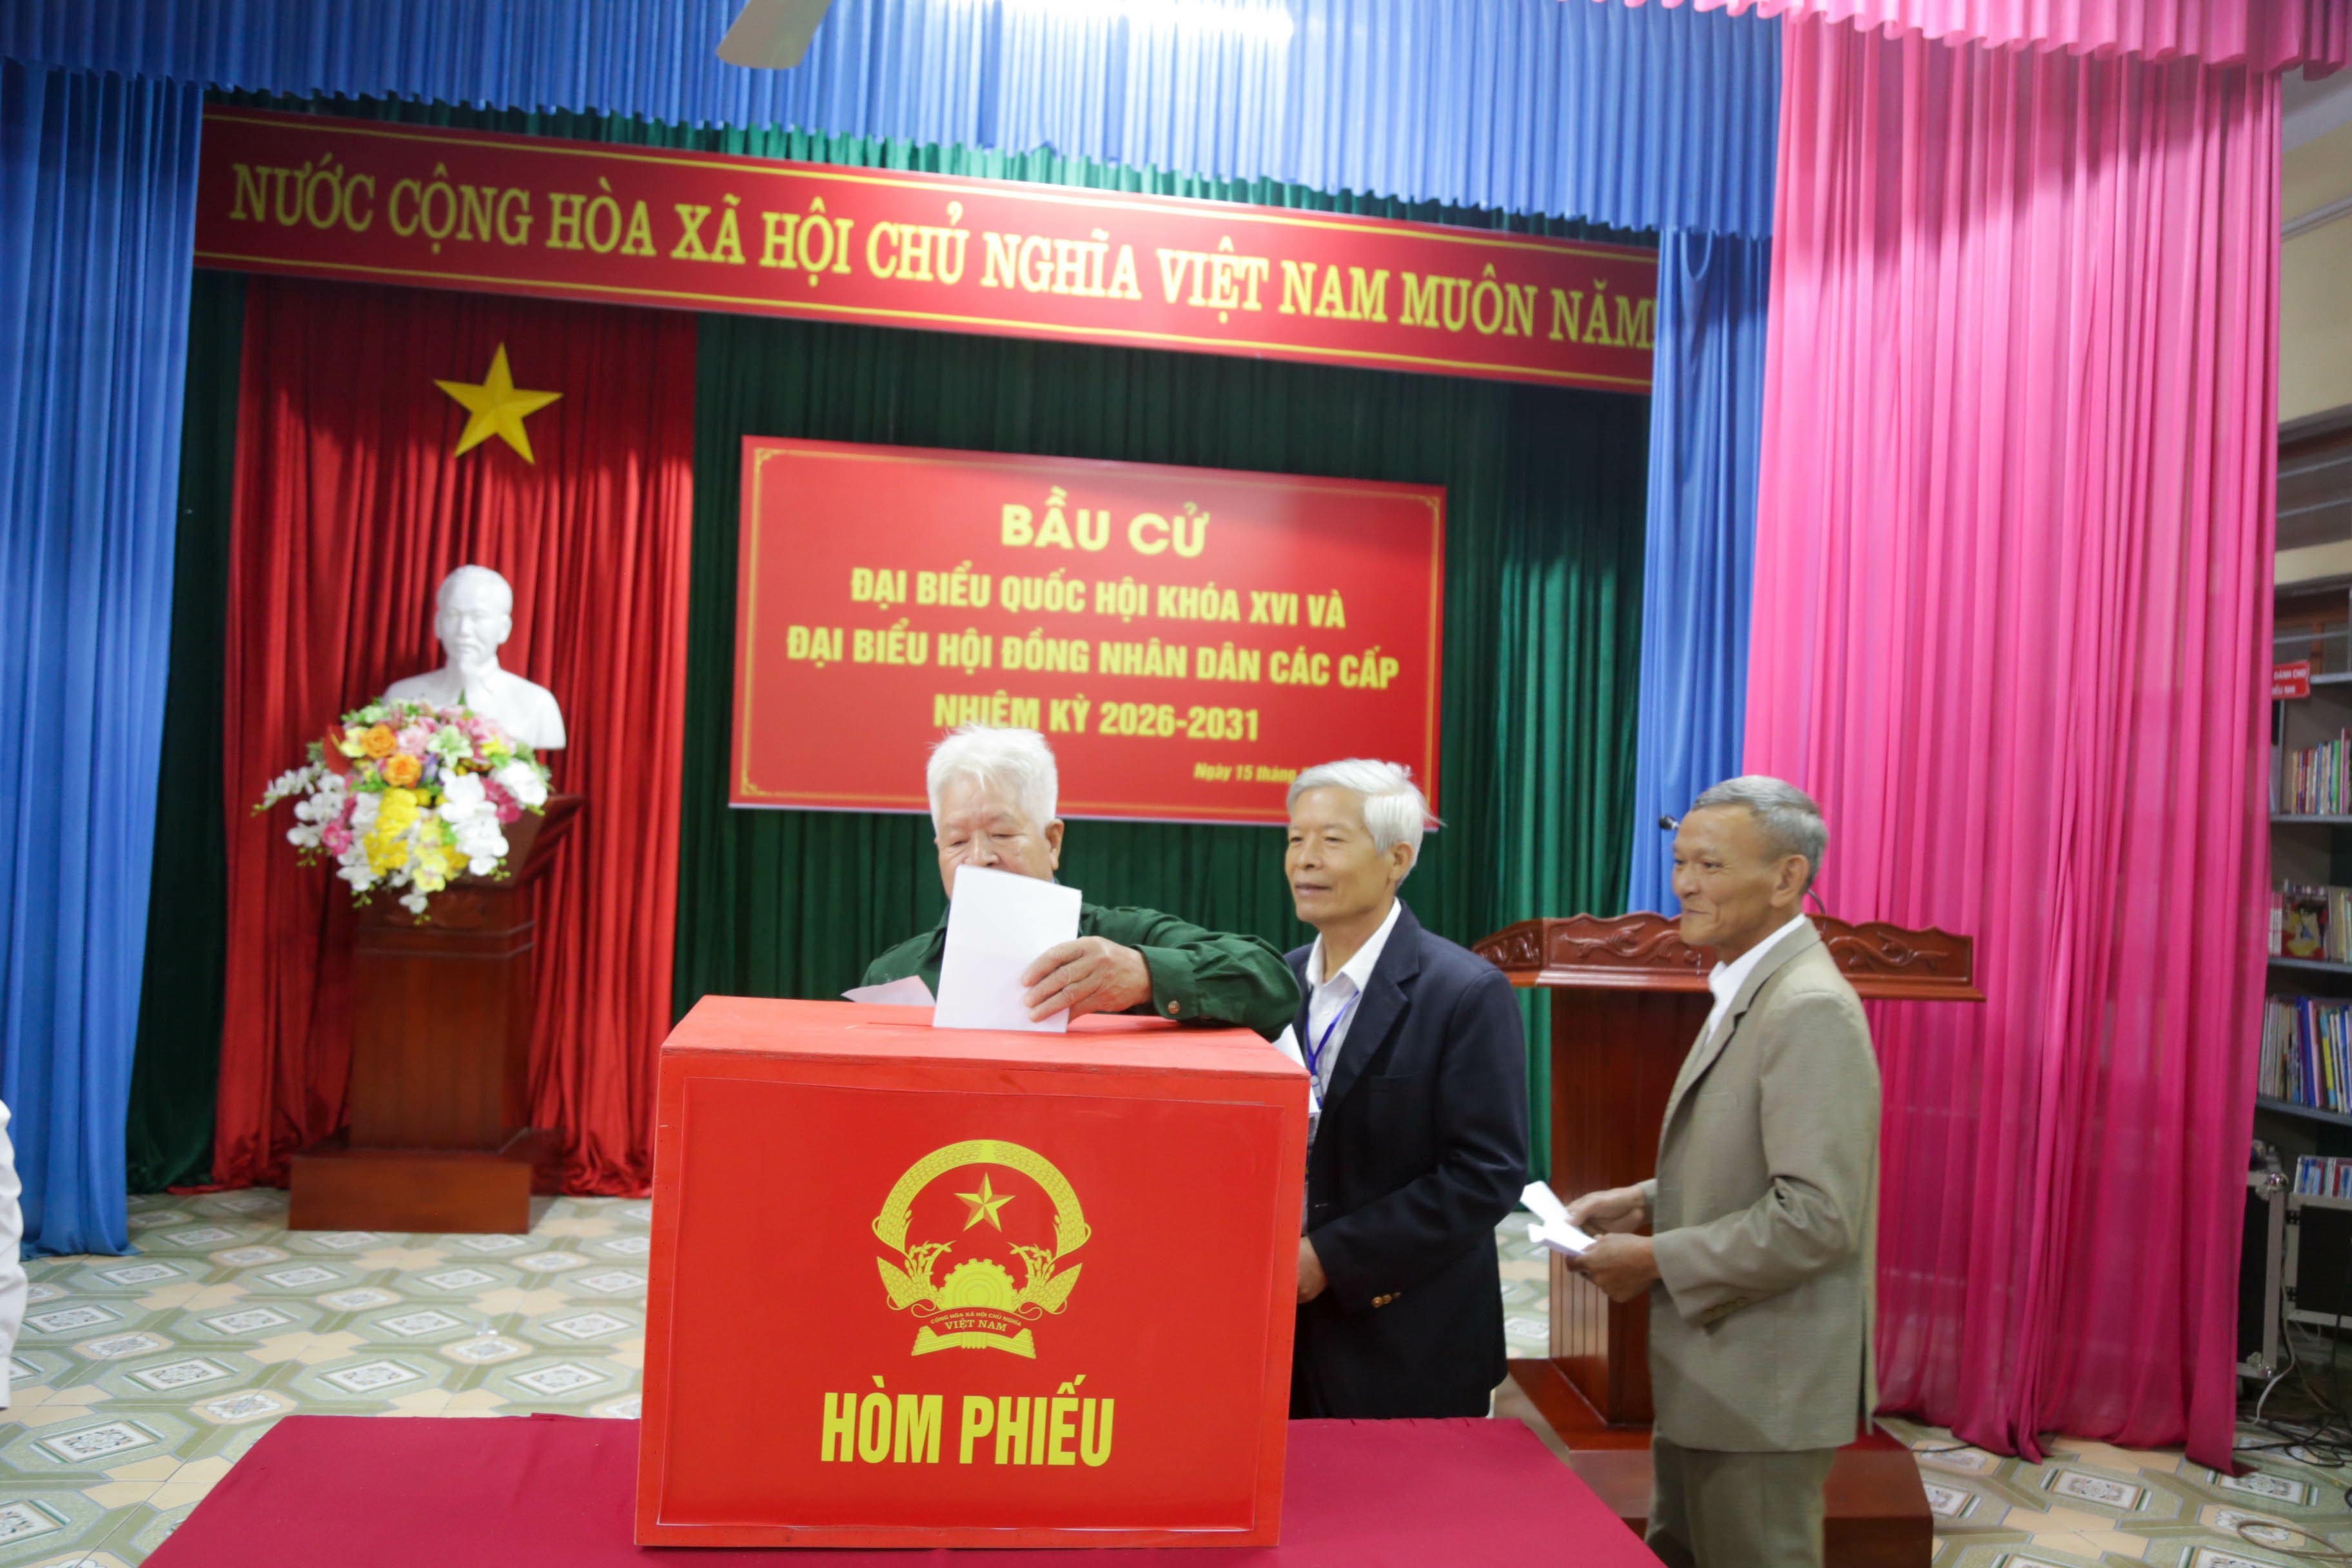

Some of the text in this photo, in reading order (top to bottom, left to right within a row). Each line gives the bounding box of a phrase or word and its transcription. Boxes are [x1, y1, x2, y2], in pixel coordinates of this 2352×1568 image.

[229, 152, 376, 232] NƯỚC
[389, 162, 533, 254] CỘNG
[547, 177, 657, 256] HÒA
[671, 193, 746, 265] XÃ
[760, 197, 854, 288] HỘI
[867, 201, 970, 286] CHỦ
[981, 228, 1142, 300] NGHĨA
[1157, 236, 1269, 324] VIỆT
[1279, 260, 1390, 322] NAM
[1400, 263, 1538, 337] MUÔN
[1001, 485, 1210, 558] BẦU CỬ
[851, 559, 1346, 629] ĐẠI BIỂU QUỐC HỘI KHÓA XVI VÀ
[787, 617, 1399, 689] ĐẠI BIỂU HỘI ĐỒNG NHÂN DÂN CÁC CẤP
[1049, 692, 1092, 733] KỲ
[1099, 701, 1259, 741] 2026-2031
[1194, 761, 1232, 782] Ngày
[1237, 764, 1253, 781] 15
[930, 1315, 948, 1324] CỘNG
[945, 1318, 1007, 1331] VIỆT NAM
[821, 1374, 1115, 1467] HÒM PHIẾU
